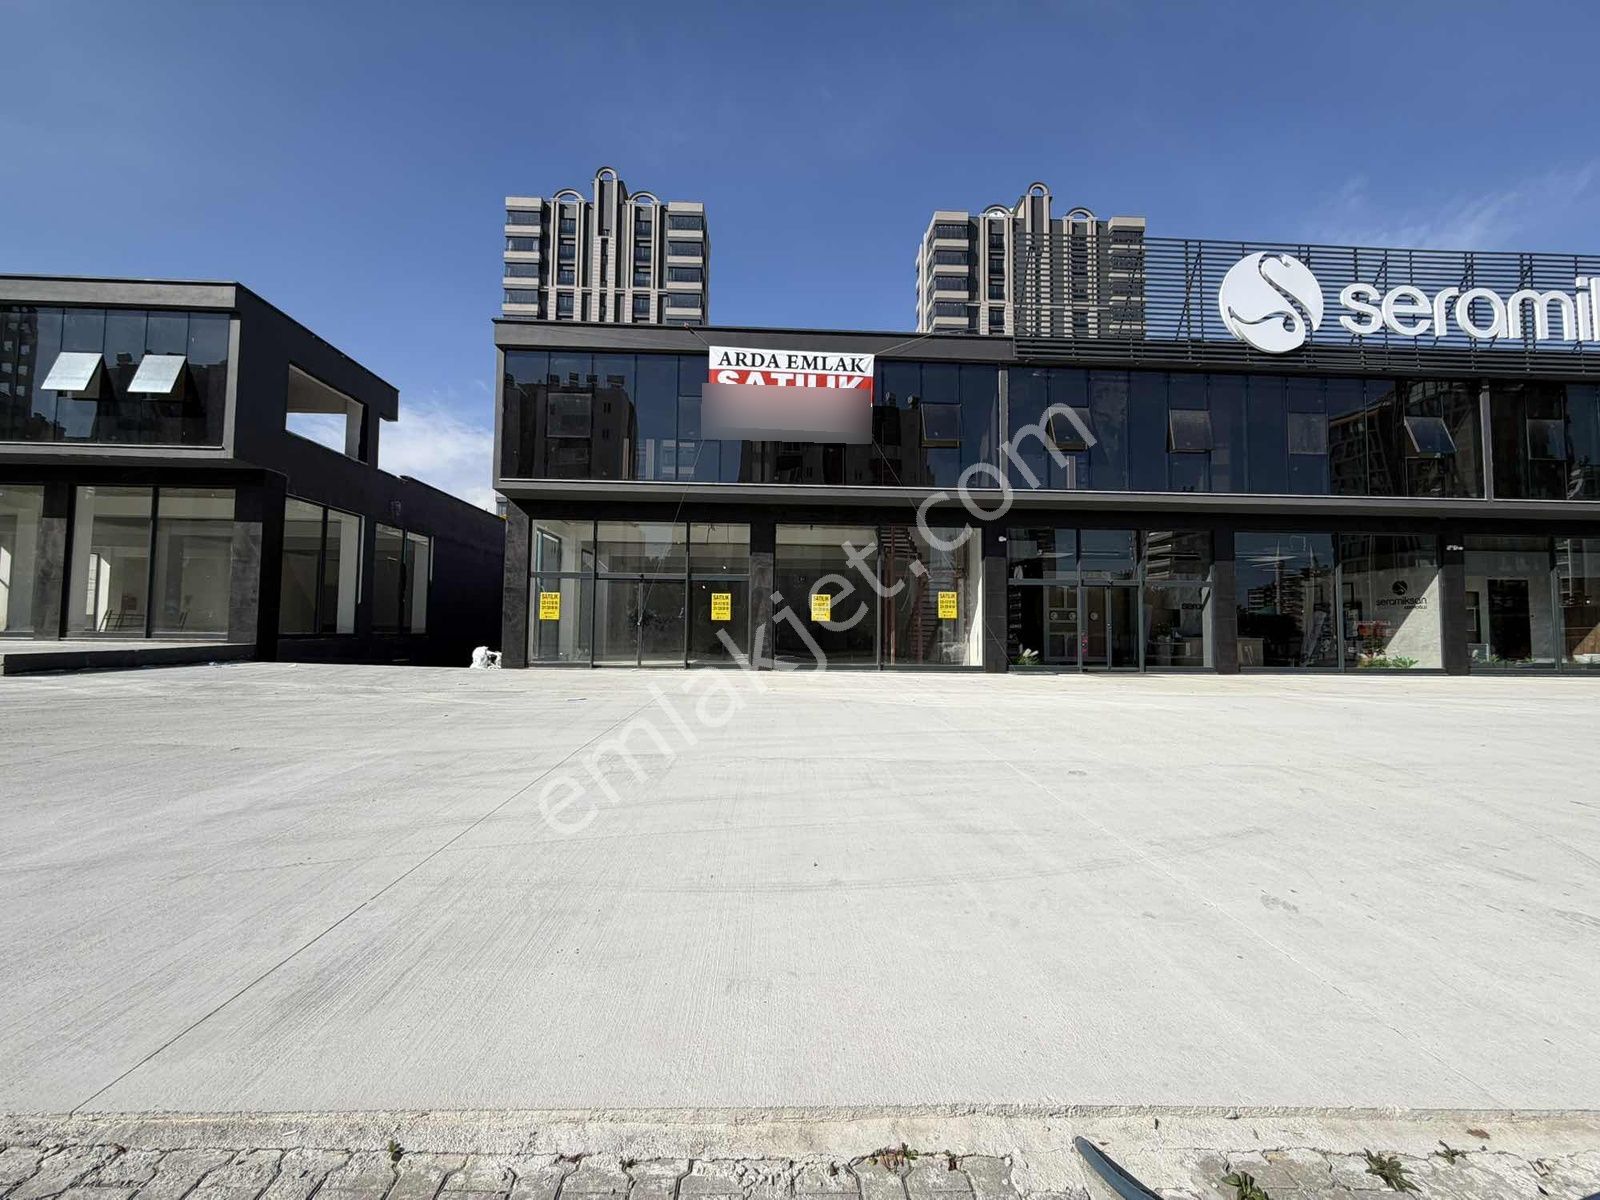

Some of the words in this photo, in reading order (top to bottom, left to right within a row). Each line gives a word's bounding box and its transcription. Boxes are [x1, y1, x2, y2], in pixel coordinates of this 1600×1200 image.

[718, 351, 780, 369] ARDA
[786, 353, 866, 373] EMLAK
[1375, 596, 1428, 607] seramiksan
